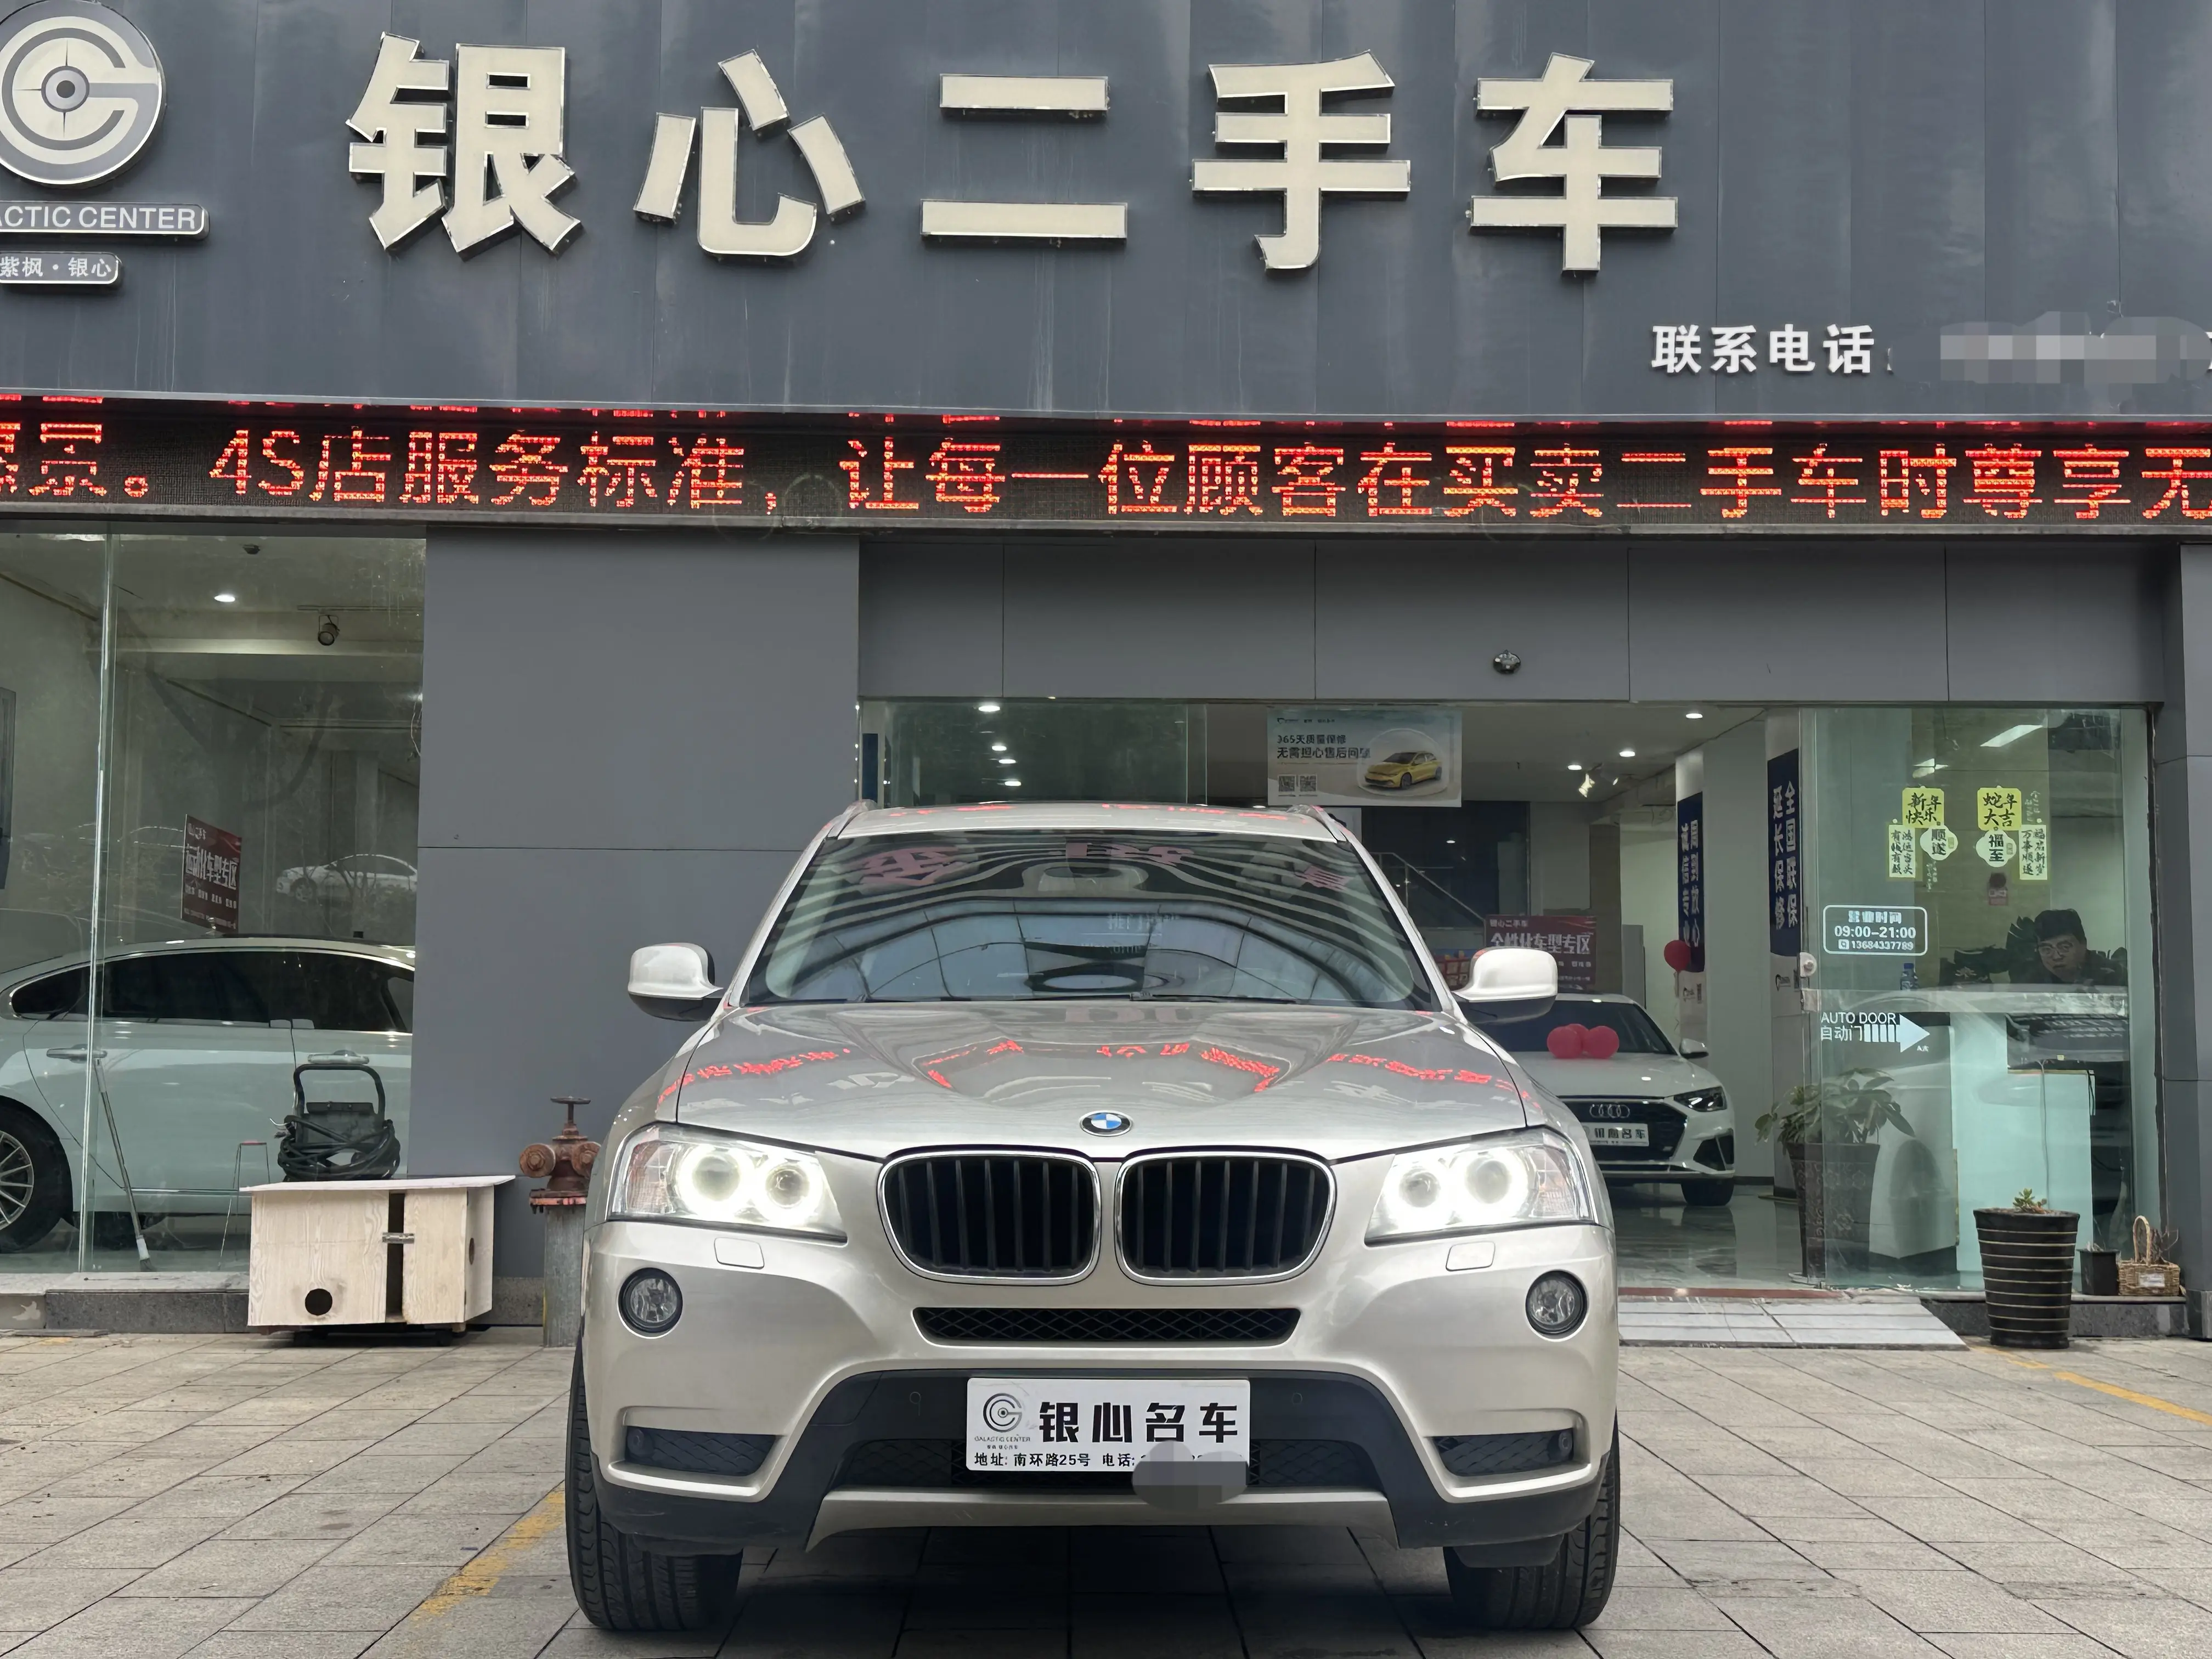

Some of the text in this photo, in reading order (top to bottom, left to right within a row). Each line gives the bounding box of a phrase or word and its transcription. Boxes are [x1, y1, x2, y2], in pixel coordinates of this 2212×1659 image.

[346, 31, 1678, 272] 银心二手车
[0, 205, 196, 229] CTIC CENTER
[1908, 792, 1942, 812] 新年
[1983, 792, 2017, 810] 蛇年
[1905, 807, 1937, 825] 快乐
[1984, 808, 2015, 827] 大吉
[1989, 834, 2004, 862] 福至
[1821, 1012, 1897, 1024] AUTO DOOR
[1820, 1025, 1863, 1042] 自动门
[1039, 1402, 1238, 1443] 银心名车
